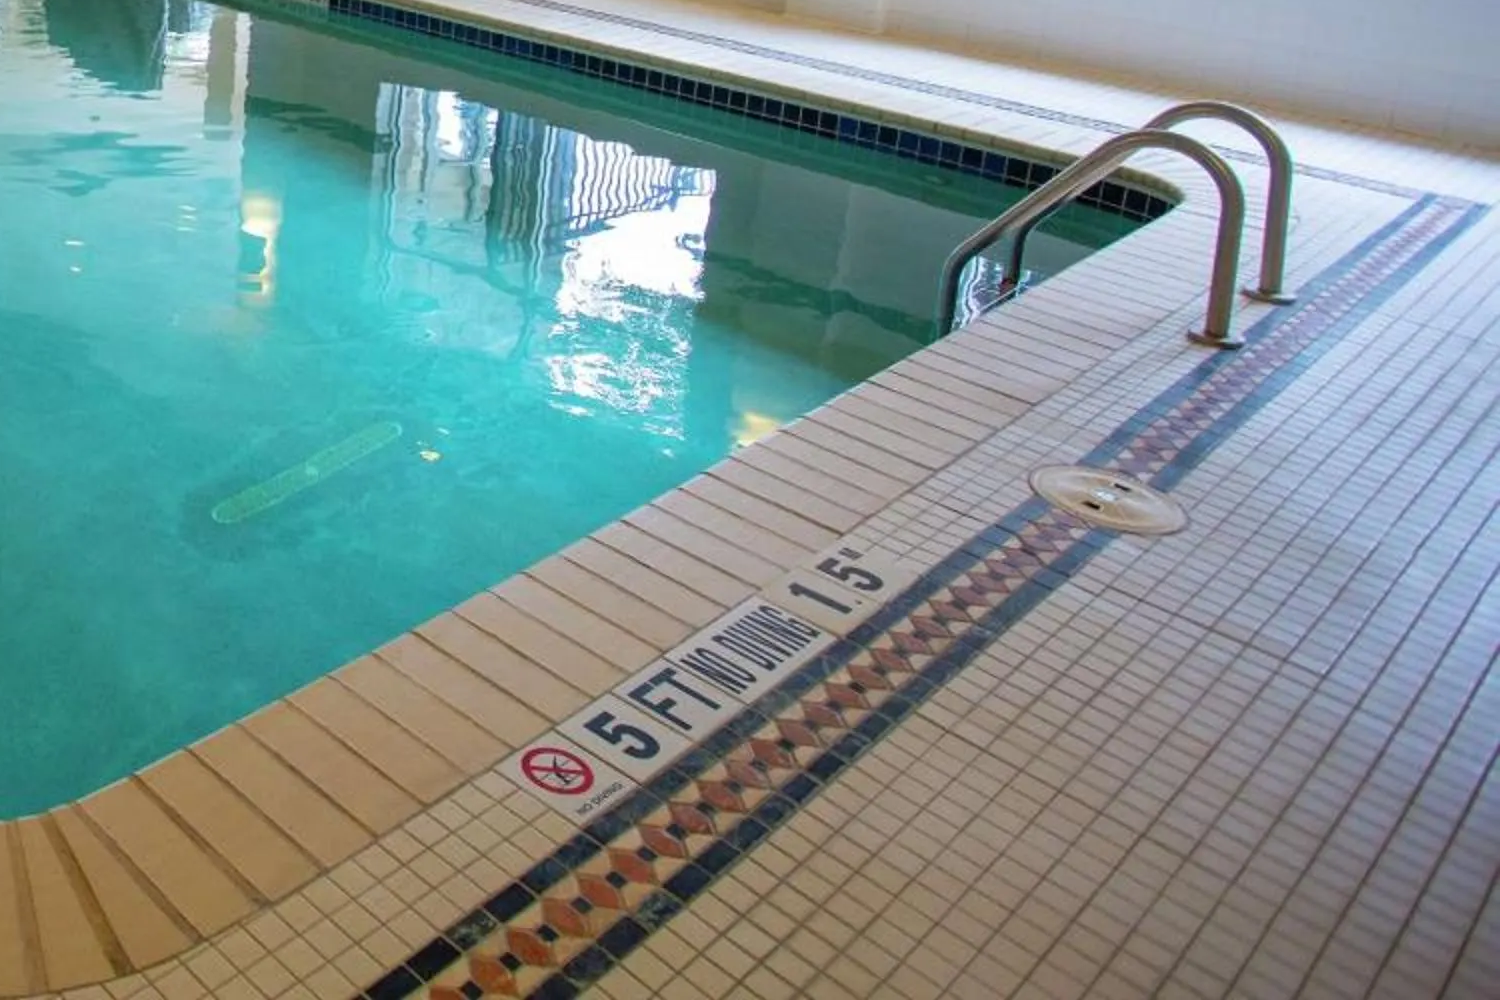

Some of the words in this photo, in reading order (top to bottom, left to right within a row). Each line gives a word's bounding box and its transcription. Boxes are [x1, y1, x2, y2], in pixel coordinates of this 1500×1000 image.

[711, 605, 820, 671] DIVING
[679, 647, 757, 694] NO
[627, 667, 721, 730] FT
[583, 711, 661, 759] 5
